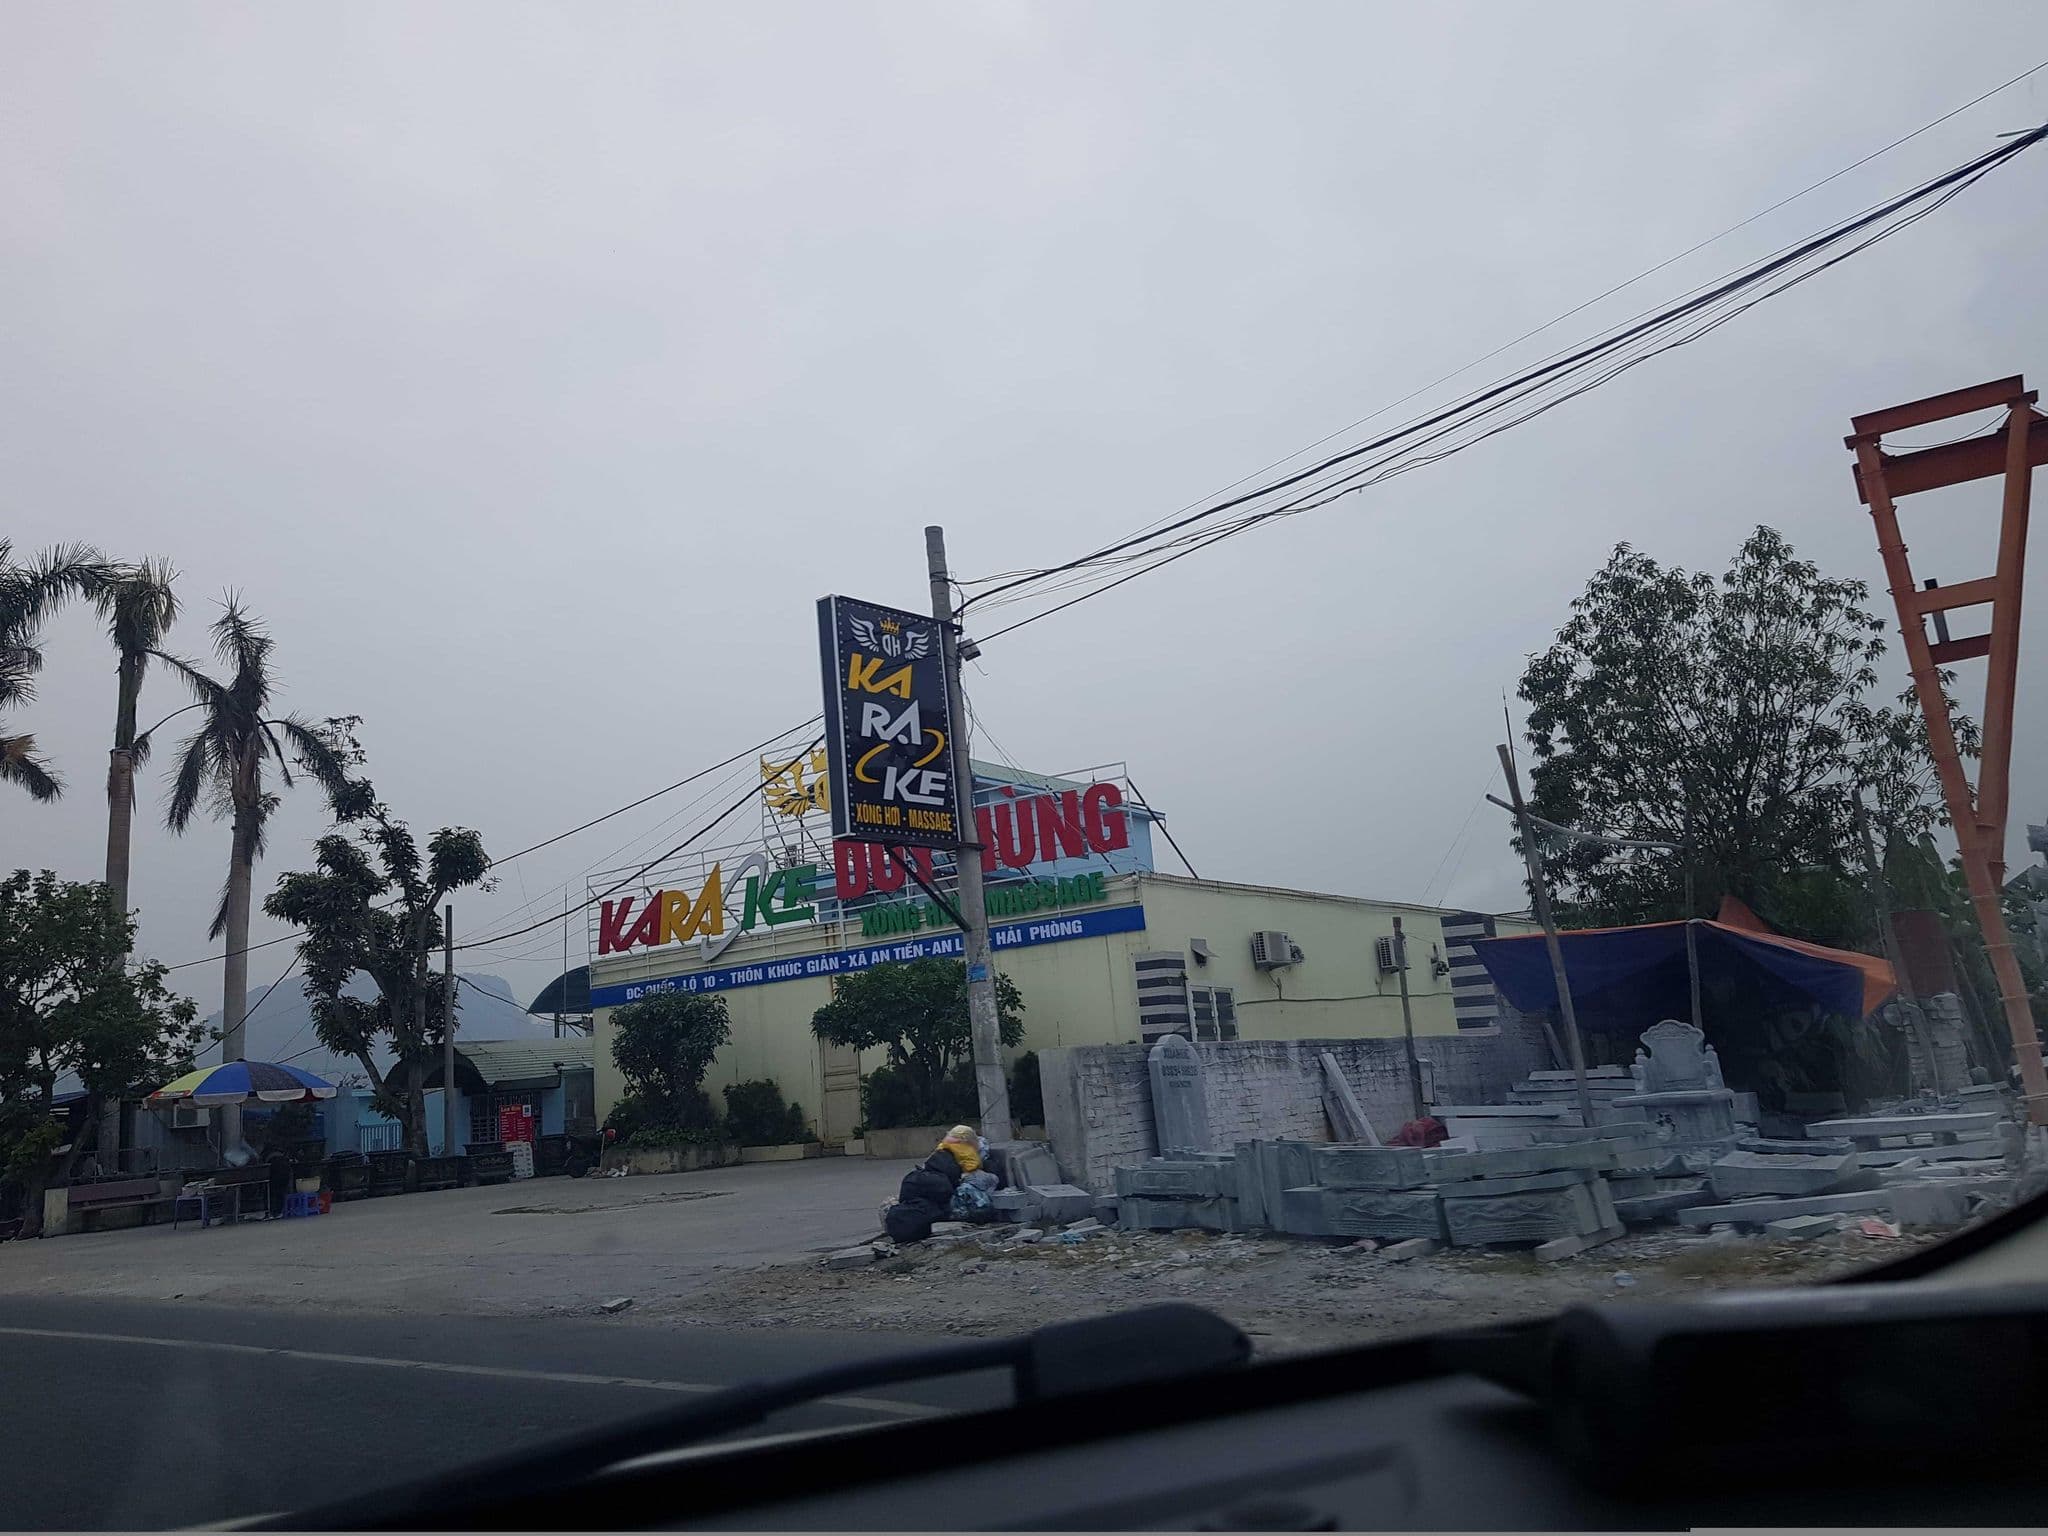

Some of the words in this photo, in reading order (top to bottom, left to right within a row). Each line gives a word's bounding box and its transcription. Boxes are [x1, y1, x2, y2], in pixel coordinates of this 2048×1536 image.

[848, 652, 913, 699] KA
[861, 700, 922, 745] RA
[883, 766, 947, 806] KE
[855, 800, 883, 825] XÔNG
[885, 806, 901, 827] HƠI
[908, 808, 953, 832] MASSAGE
[860, 902, 921, 937] XÔNG
[984, 871, 1108, 917] MASSAGE
[703, 975, 716, 989] 10
[730, 966, 763, 984] THÔN
[768, 961, 802, 979] KHÚC
[871, 950, 890, 964] AN
[893, 942, 923, 959] TIẾN
[932, 939, 952, 955] AN
[996, 926, 1022, 945] HẢI
[1030, 920, 1083, 941] PHÒNG
